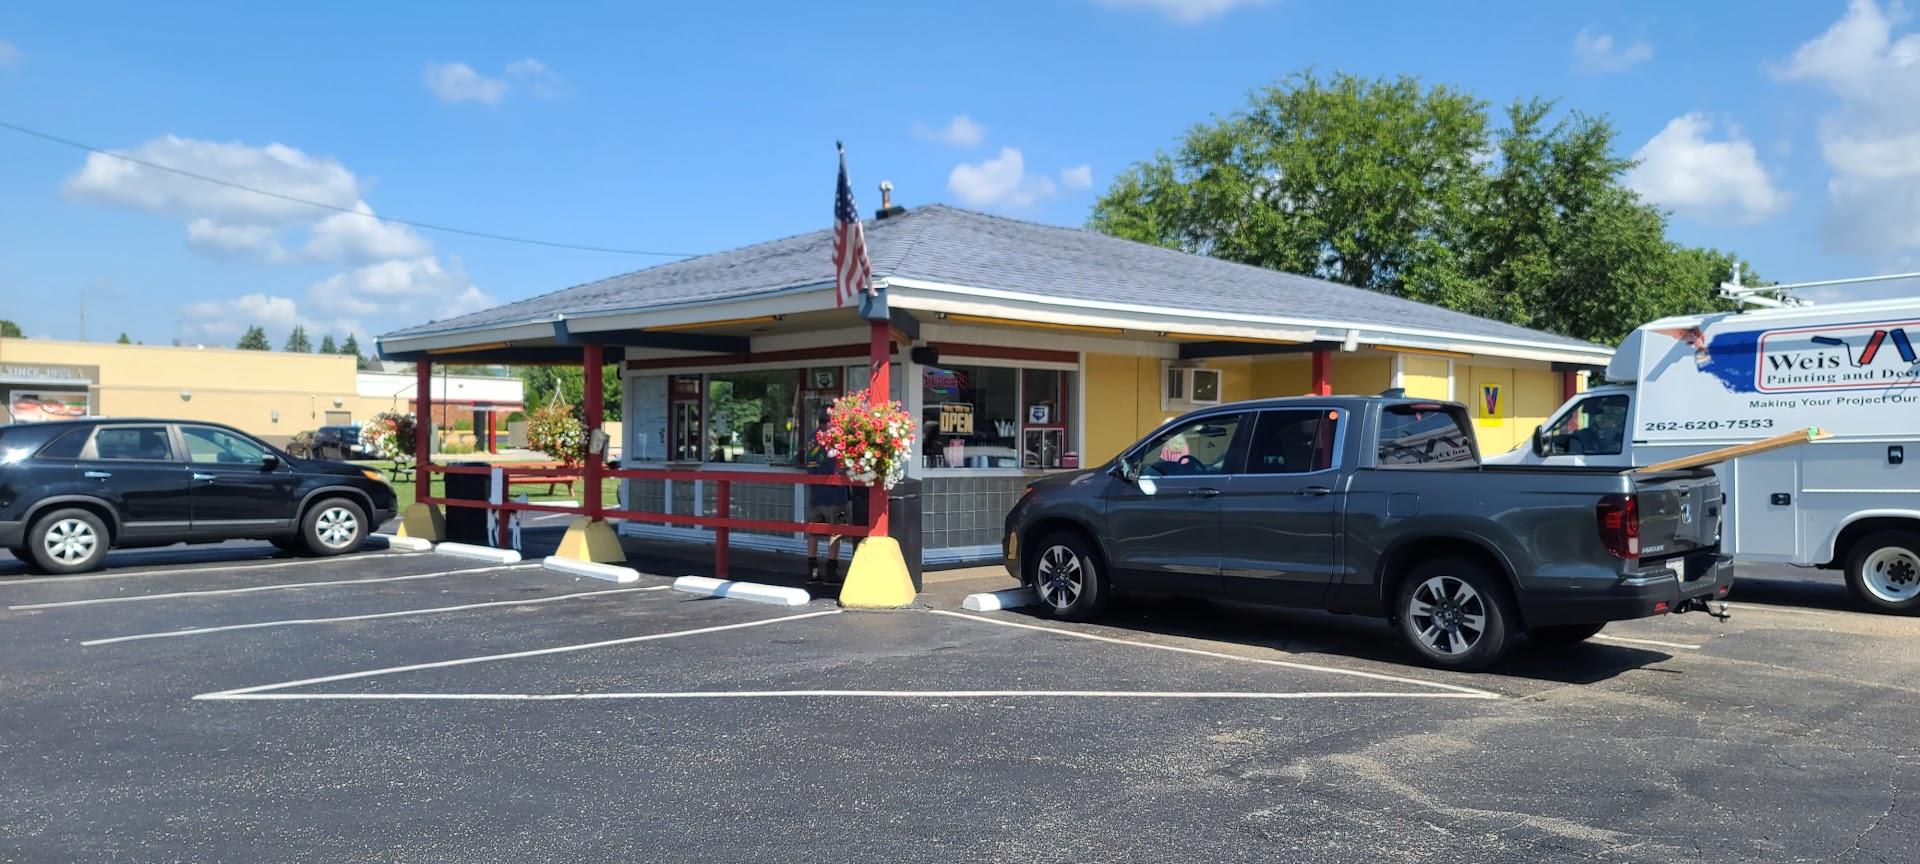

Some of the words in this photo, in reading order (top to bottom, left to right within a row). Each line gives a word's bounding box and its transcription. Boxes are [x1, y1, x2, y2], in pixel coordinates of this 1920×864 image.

[1767, 351, 1840, 371] Weis
[923, 374, 968, 389] BURGERS
[1766, 372, 1836, 384] Painting
[1842, 369, 1873, 381] and
[1749, 399, 1796, 409] Making
[1801, 397, 1833, 407] Your
[1836, 395, 1886, 406] Project
[1891, 394, 1918, 404] Our
[941, 412, 972, 433] OPEN
[1645, 418, 1774, 431] 262-620-7553
